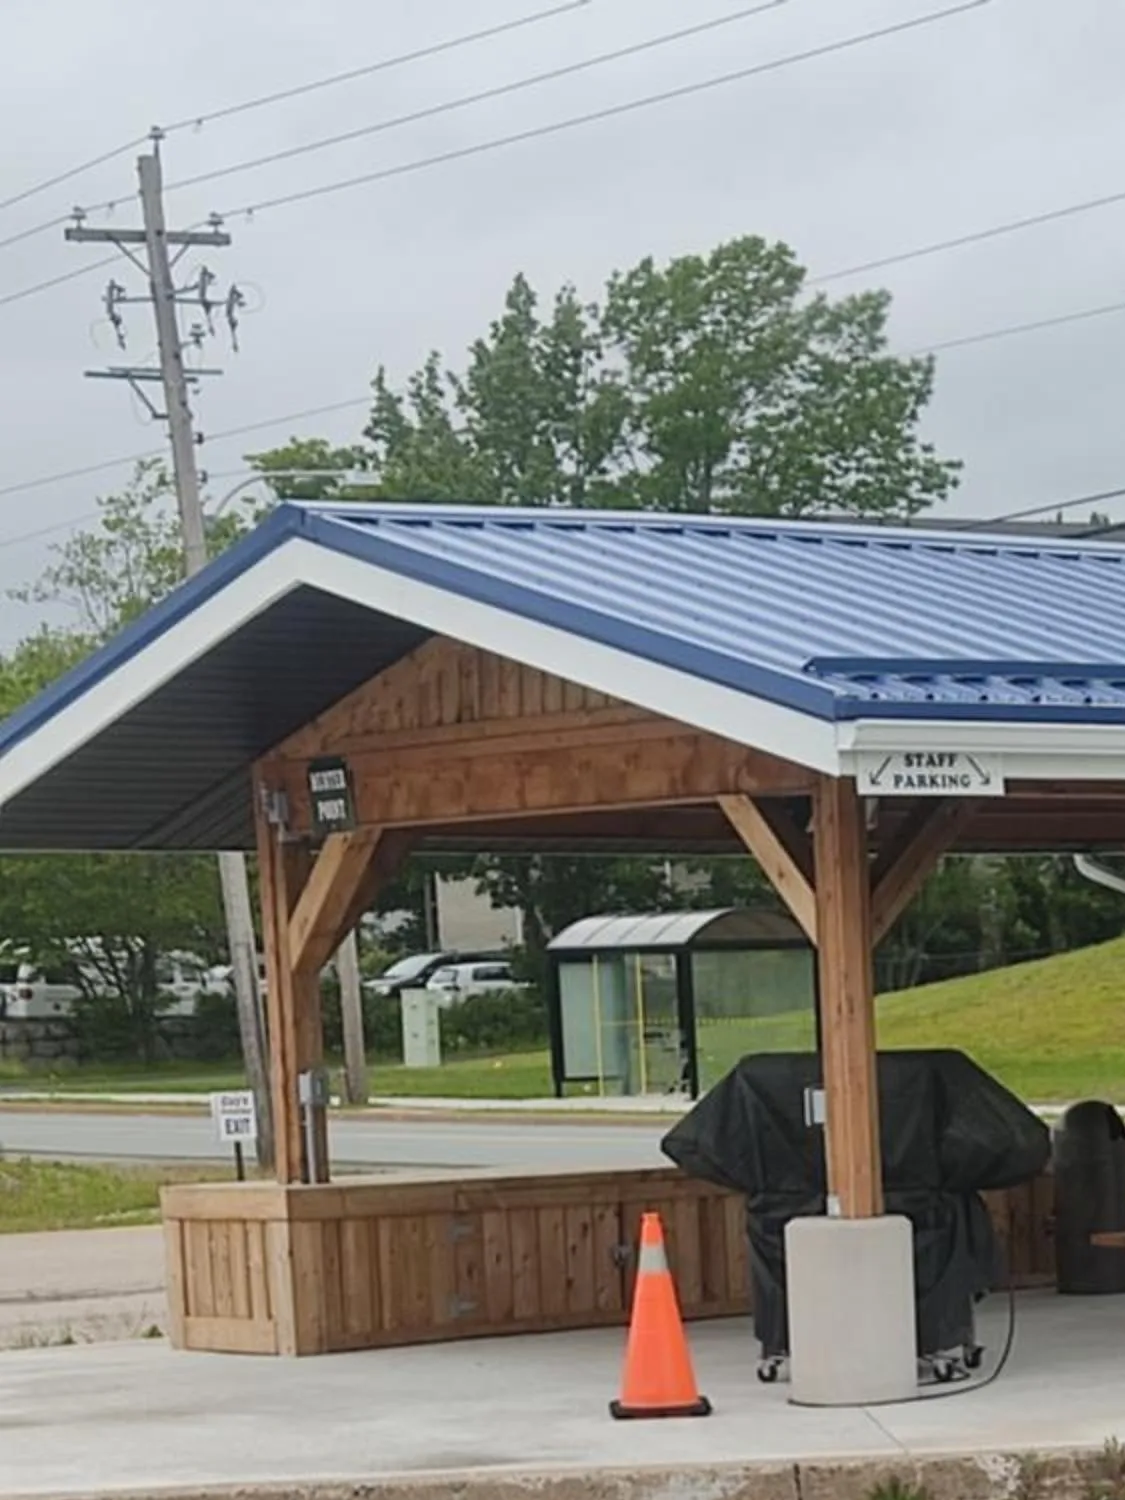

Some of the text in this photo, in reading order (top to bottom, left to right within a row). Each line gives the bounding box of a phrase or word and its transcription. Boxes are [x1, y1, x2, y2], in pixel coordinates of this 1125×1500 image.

[904, 753, 957, 767] STAFF
[894, 774, 971, 788] PARKING
[225, 1118, 249, 1135] EXIT
